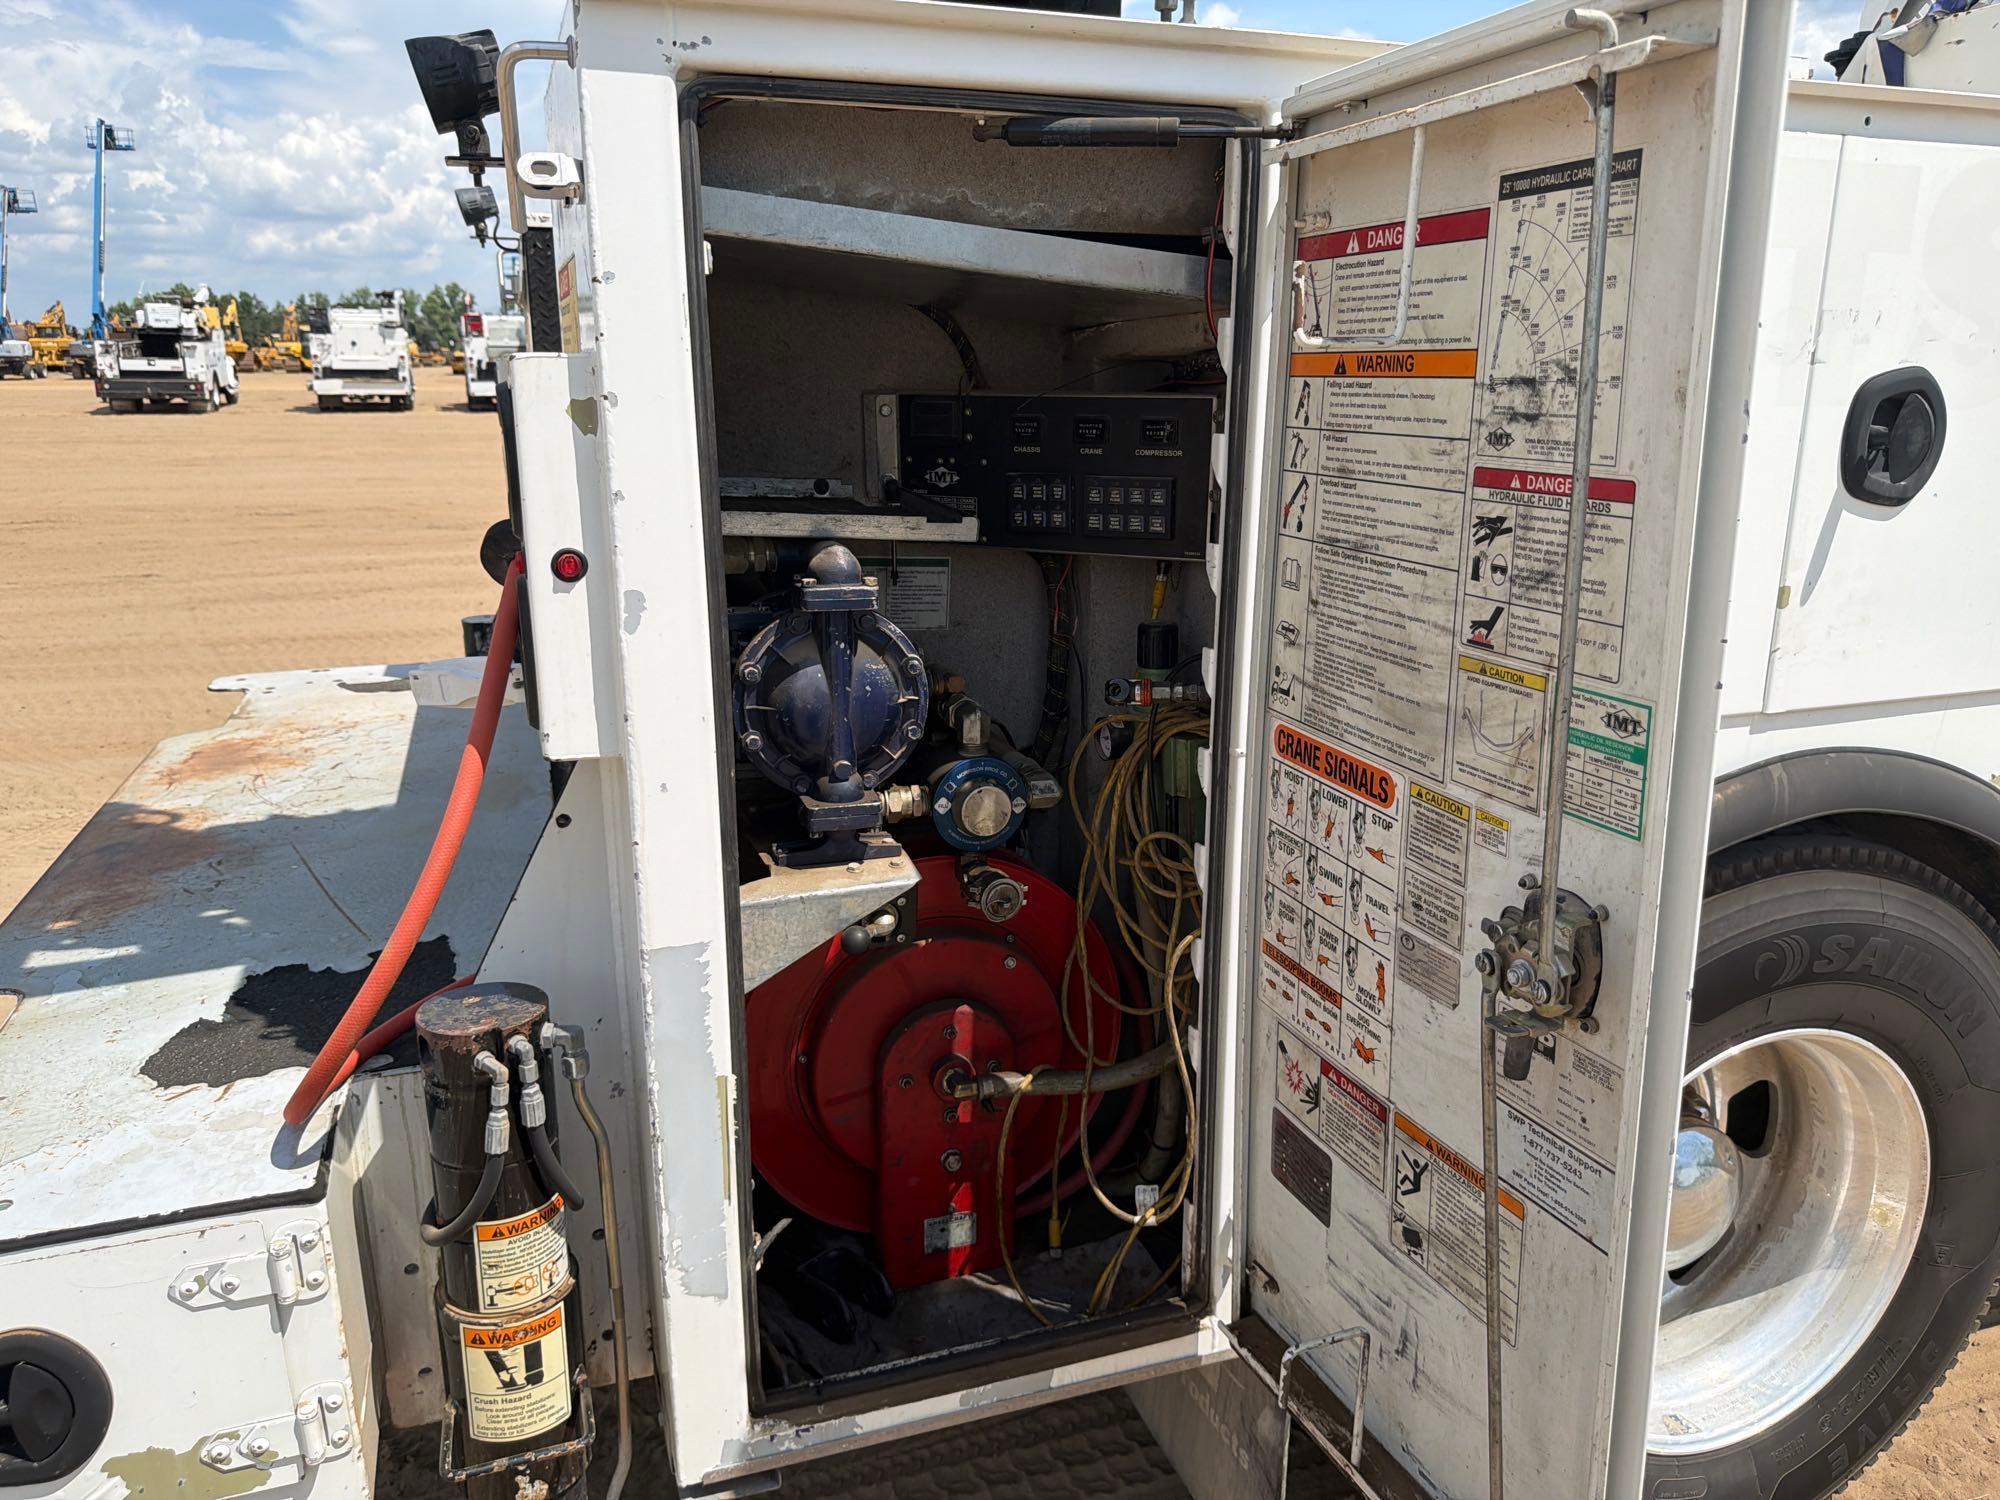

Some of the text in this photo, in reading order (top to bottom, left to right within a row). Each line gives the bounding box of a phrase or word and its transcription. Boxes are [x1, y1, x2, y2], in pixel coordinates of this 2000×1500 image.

[1503, 182, 1512, 193] 25'
[1532, 171, 1571, 188] HYDRAULIC
[1572, 168, 1596, 180] CAPAC
[1367, 224, 1421, 249] DANGR
[1335, 257, 1384, 270] Electrocution Hazard
[1434, 276, 1453, 284] equipment
[1424, 336, 1444, 346] contacting
[1356, 354, 1415, 372] WARNING
[1326, 381, 1342, 389] Falling
[1356, 381, 1372, 389] Hazard
[1333, 435, 1347, 443] Hazard
[1489, 432, 1512, 446] IMT
[928, 472, 958, 483] IMT
[1320, 478, 1356, 490] Overload Hazard
[1526, 475, 1573, 493] DANGE
[1489, 490, 1611, 513] HYDRAULIC FLUID HARDS
[1529, 514, 1550, 522] pressure
[1537, 527, 1557, 535] pressure
[1605, 537, 1625, 545] system.
[1315, 545, 1329, 555] Follow
[1330, 548, 1341, 557] Safe
[1342, 551, 1364, 563] Operating
[1370, 557, 1395, 570] Inspection
[1396, 563, 1427, 576] Procedures
[1517, 625, 1548, 636] temperatures
[1549, 632, 1559, 640] may
[1517, 644, 1534, 653] surface
[1467, 675, 1480, 684] AVOID
[1481, 678, 1508, 694] EQUIPMENT
[1489, 667, 1525, 684] CAUTION
[1582, 694, 1598, 706] Tooling
[1606, 712, 1641, 736] IMT
[1277, 729, 1389, 804] CRANE SIGNALS
[1589, 756, 1638, 776] TEMPERATURE RANGE
[1604, 755, 1624, 765] AMBIENT
[1284, 768, 1304, 787] HOIST
[1322, 788, 1348, 810] LOWER
[1586, 789, 1598, 797] Below
[1423, 804, 1446, 819] EQUIPMENT
[1425, 791, 1463, 817] CAUTION
[1614, 800, 1627, 808] Below
[1371, 813, 1394, 831] STOP
[1481, 812, 1503, 828] CAUTION
[1613, 811, 1627, 819] Above
[1275, 828, 1303, 848] EMERGENCY
[1278, 841, 1295, 857] STOP
[1318, 865, 1343, 888] SWING
[1419, 880, 1433, 890] service
[1365, 894, 1390, 916] TRAVEL
[1408, 890, 1459, 921] YOUR AUTHORIZED
[1425, 908, 1447, 925] DEALER
[1318, 926, 1339, 945] LOWER
[1320, 937, 1337, 954] BOOM
[1264, 943, 1338, 1004] TELESCOPING BOOMS
[1264, 961, 1295, 989] EXTEND BOOM
[1358, 984, 1377, 1004] MOVE
[1812, 934, 1987, 1040] SAILUN
[1301, 988, 1338, 1020] RETRACT BOOM
[1355, 993, 1381, 1016] SLOWLY
[1346, 1013, 1382, 1043] EVERYTHING
[1358, 1013, 1370, 1026] DOG
[1340, 1078, 1380, 1116] DANGER
[1507, 1110, 1602, 1178] SWP Technical Support
[1435, 1144, 1485, 1188] WARNING
[1429, 1154, 1482, 1198] FALL HAZARDS
[507, 1197, 564, 1235] WARNING
[508, 1234, 531, 1246] AVOID
[474, 1393, 532, 1405] Crush Hazard
[495, 1404, 525, 1413] extending
[507, 1419, 537, 1430] stabilizers
[548, 1406, 565, 1420] people
